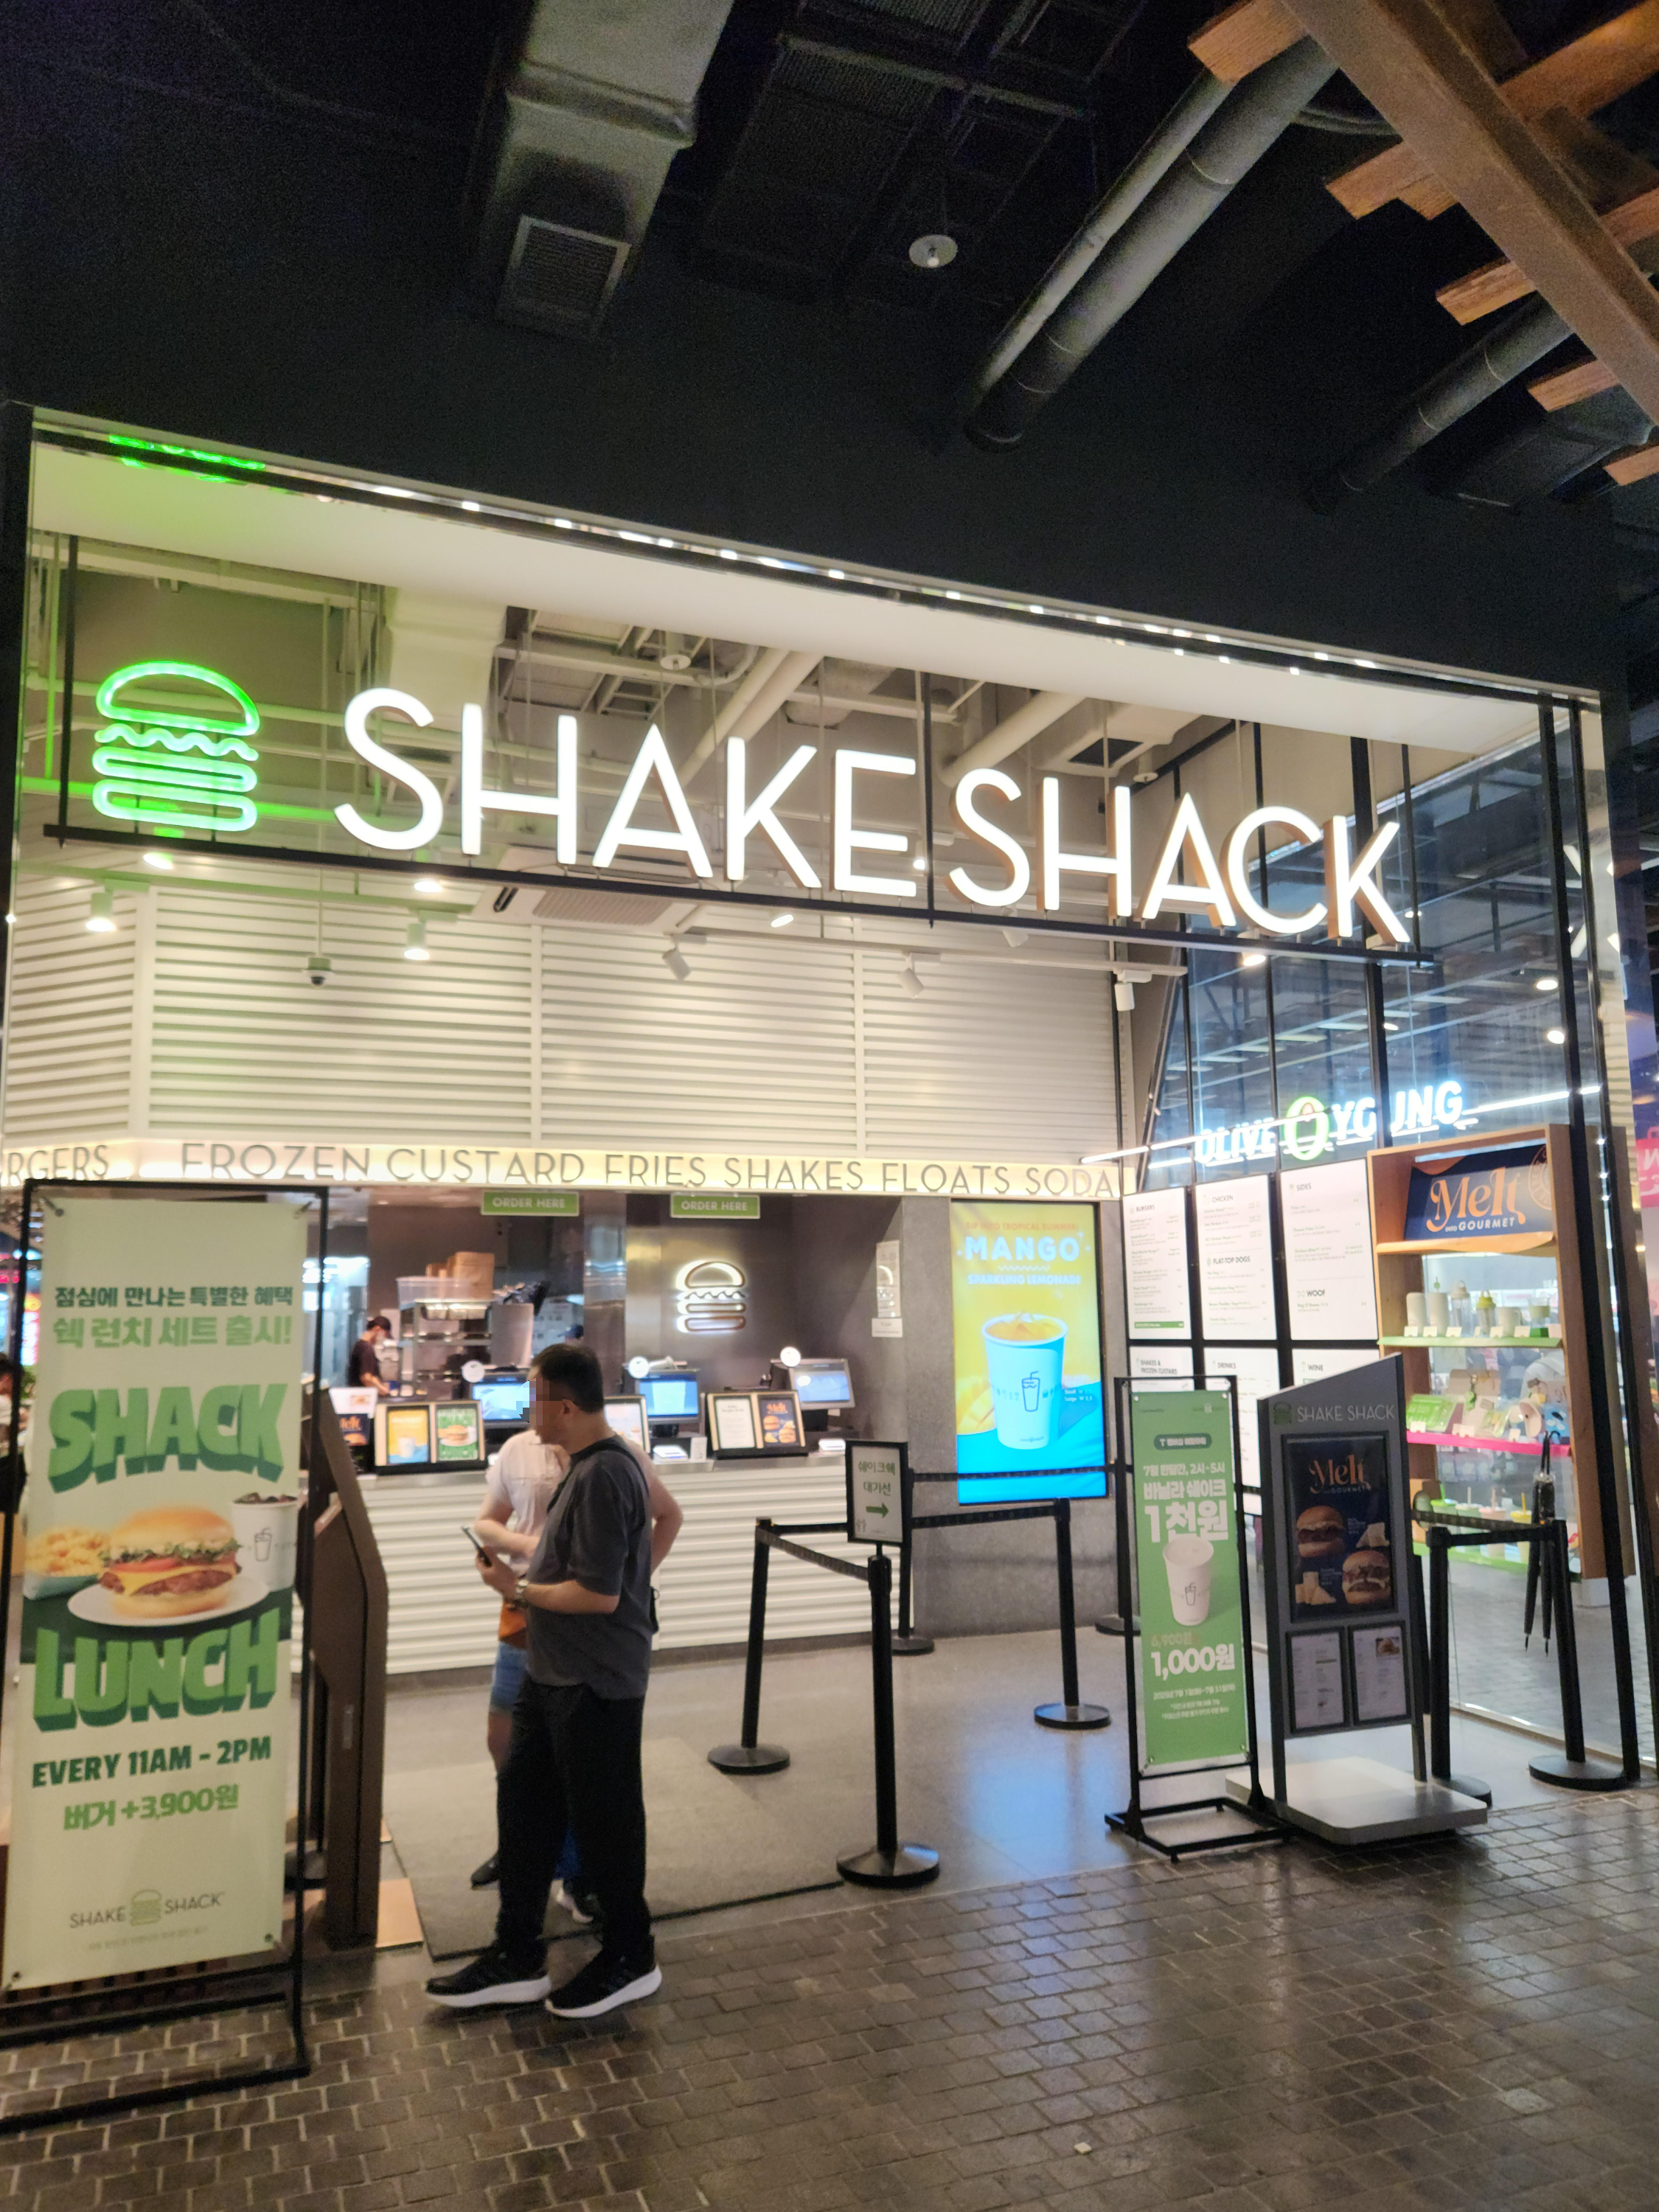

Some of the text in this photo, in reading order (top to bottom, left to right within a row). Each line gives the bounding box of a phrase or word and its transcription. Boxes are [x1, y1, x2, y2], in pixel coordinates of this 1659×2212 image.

[335, 687, 1411, 946] SHAKE SHACK
[0, 1144, 109, 1185] RGERS
[181, 1143, 1114, 1198] FROZEN CUSTARD FRIES SHAKES FLOATS SODA
[1211, 1194, 1234, 1203] CHICKEN
[1295, 1183, 1312, 1192] SIDES
[1426, 1166, 1526, 1232] Melt
[493, 1197, 566, 1209] ORDER HERE
[681, 1200, 748, 1212] ORDER HERE
[1135, 1204, 1155, 1212] BURGERS
[1458, 1217, 1516, 1232] GOURMET
[964, 1235, 1080, 1262] MANGO
[1235, 1255, 1251, 1264] DOGS
[967, 1273, 1082, 1285] SPARKLING LEMONADE
[55, 1285, 294, 1309] 점심에 만나는 특별한 혜택
[1307, 1289, 1326, 1298] WOOF
[91, 1316, 153, 1349] 런치
[158, 1315, 218, 1348] 세트
[1217, 1362, 1237, 1370] DRINKS
[1296, 1404, 1396, 1423] SHAKE SHACK
[47, 1382, 288, 1495] SHACK
[863, 1481, 891, 1496] 대기선
[1144, 1478, 1227, 1500] 바닐라 쉐이크
[1144, 1499, 1229, 1543] 1천원
[33, 1607, 281, 1733] LUNCH
[1150, 1643, 1236, 1682] 1,000원
[32, 1752, 122, 1790] EVERY
[128, 1744, 192, 1778] 11AM
[215, 1735, 272, 1766] 2PM
[63, 1783, 239, 1831] 버거 +3,900원
[69, 1891, 222, 1930] SHAKE SHACK
